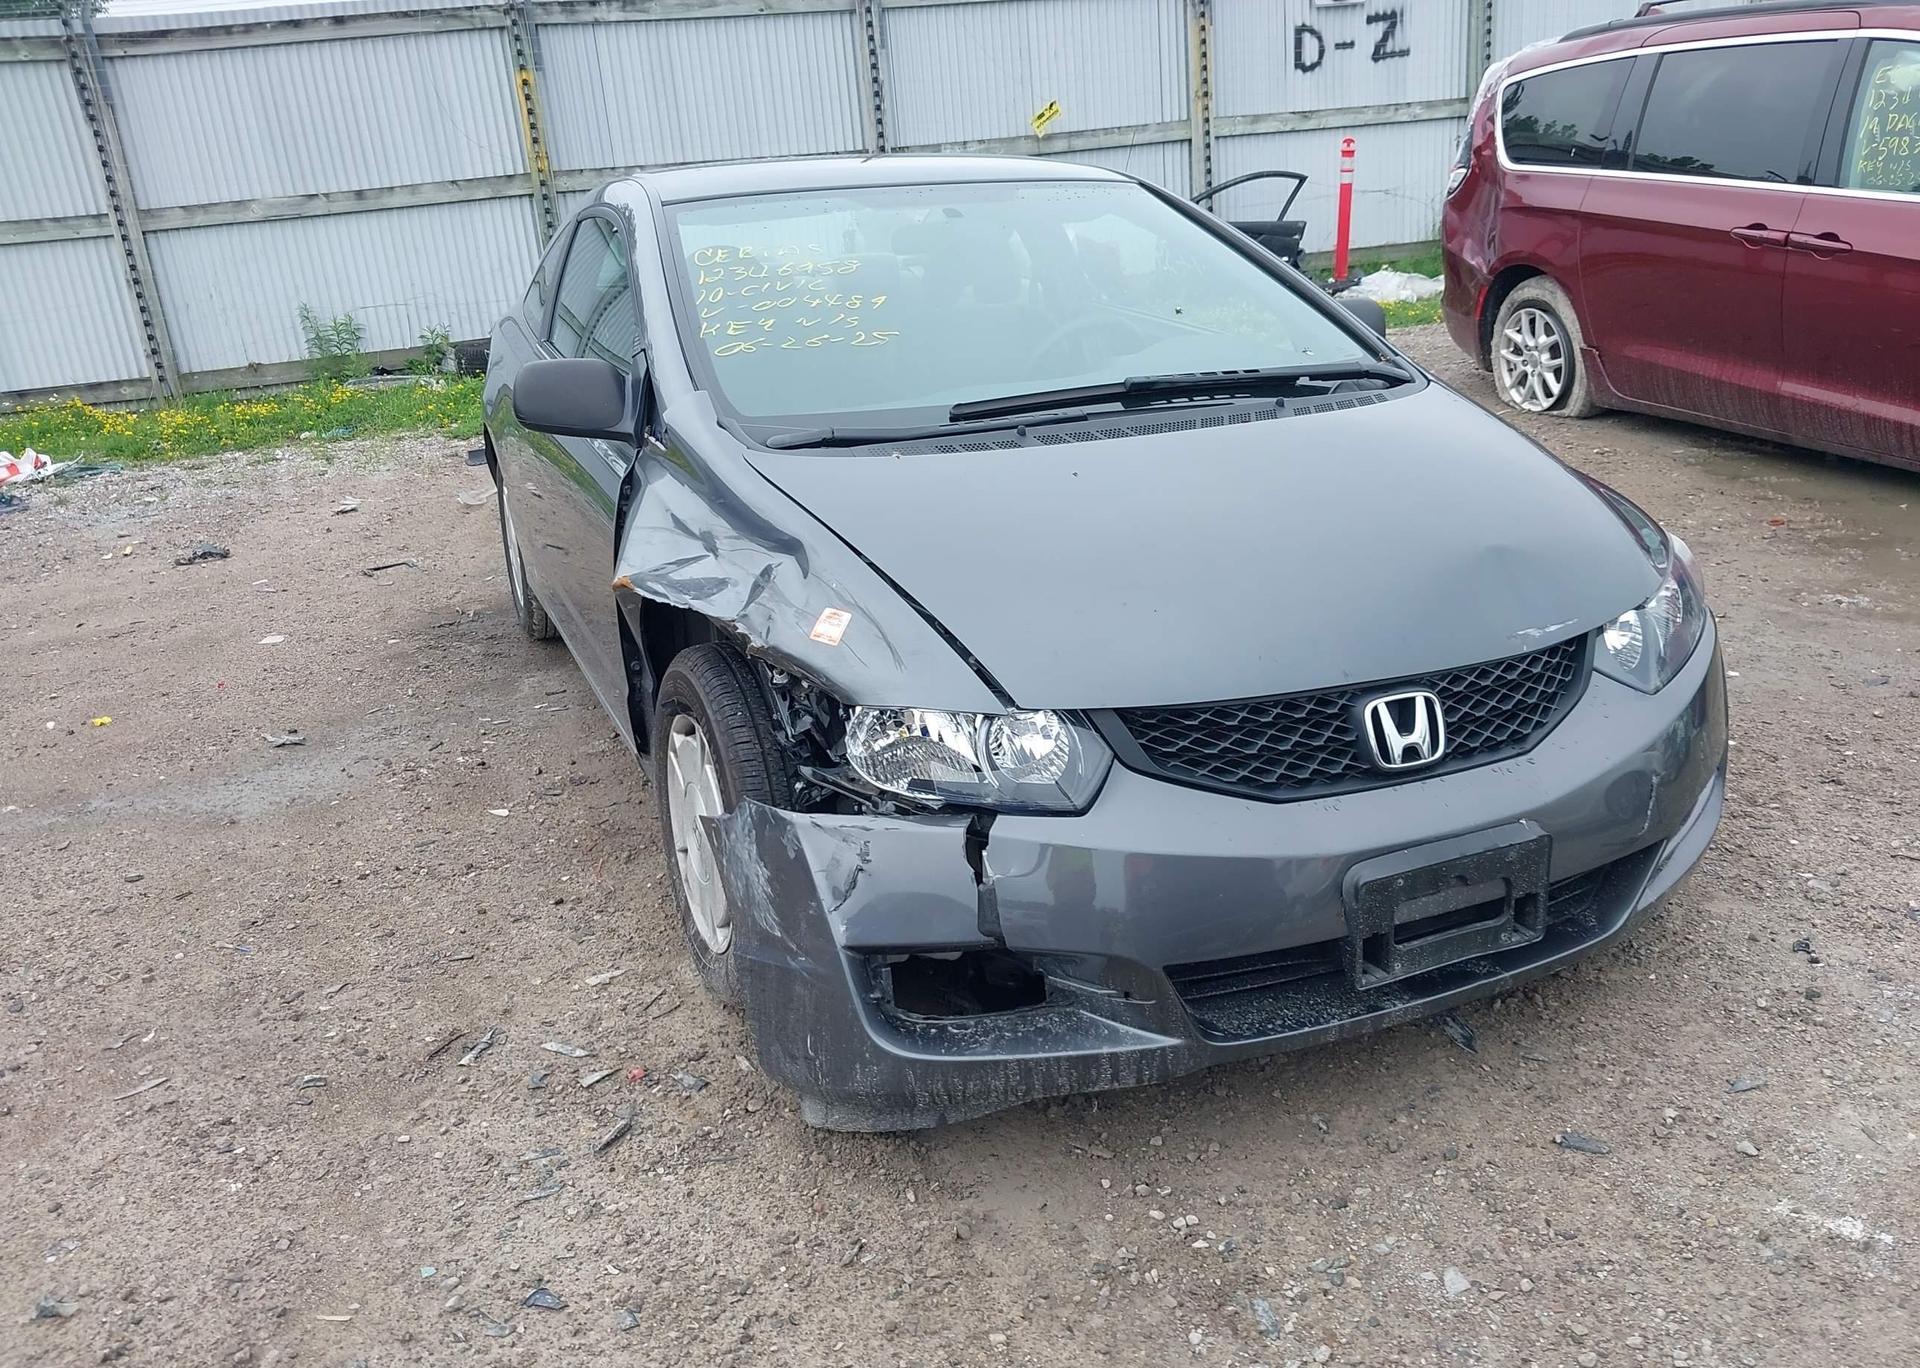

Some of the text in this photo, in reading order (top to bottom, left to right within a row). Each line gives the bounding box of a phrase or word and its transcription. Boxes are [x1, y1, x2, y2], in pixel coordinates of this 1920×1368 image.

[1294, 9, 1411, 74] D-Z
[1869, 86, 1920, 110] 1234
[700, 317, 776, 338] KEY
